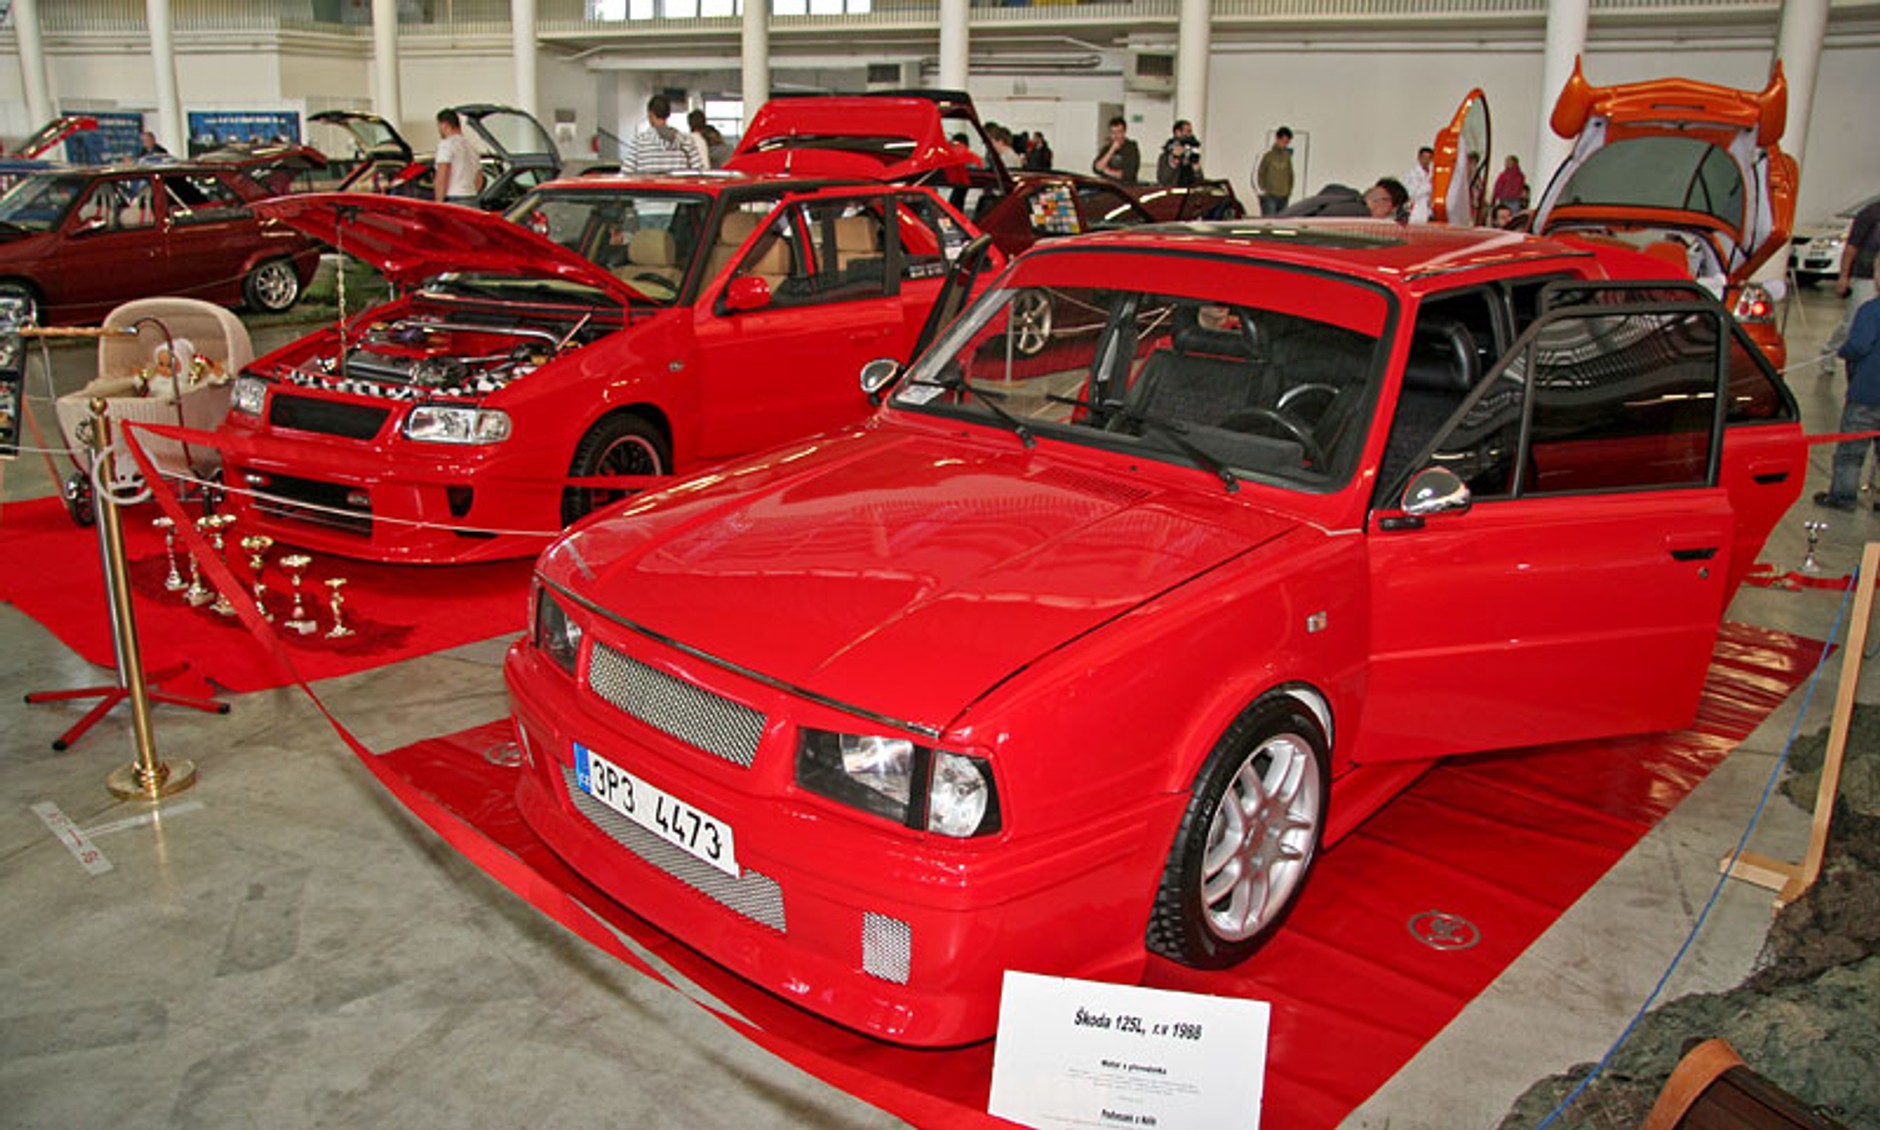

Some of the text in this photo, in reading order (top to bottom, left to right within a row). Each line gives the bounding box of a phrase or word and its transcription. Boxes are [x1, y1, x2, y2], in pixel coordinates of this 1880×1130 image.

[593, 759, 722, 859] 3P3 4473
[1074, 1006, 1111, 1029] Škoda
